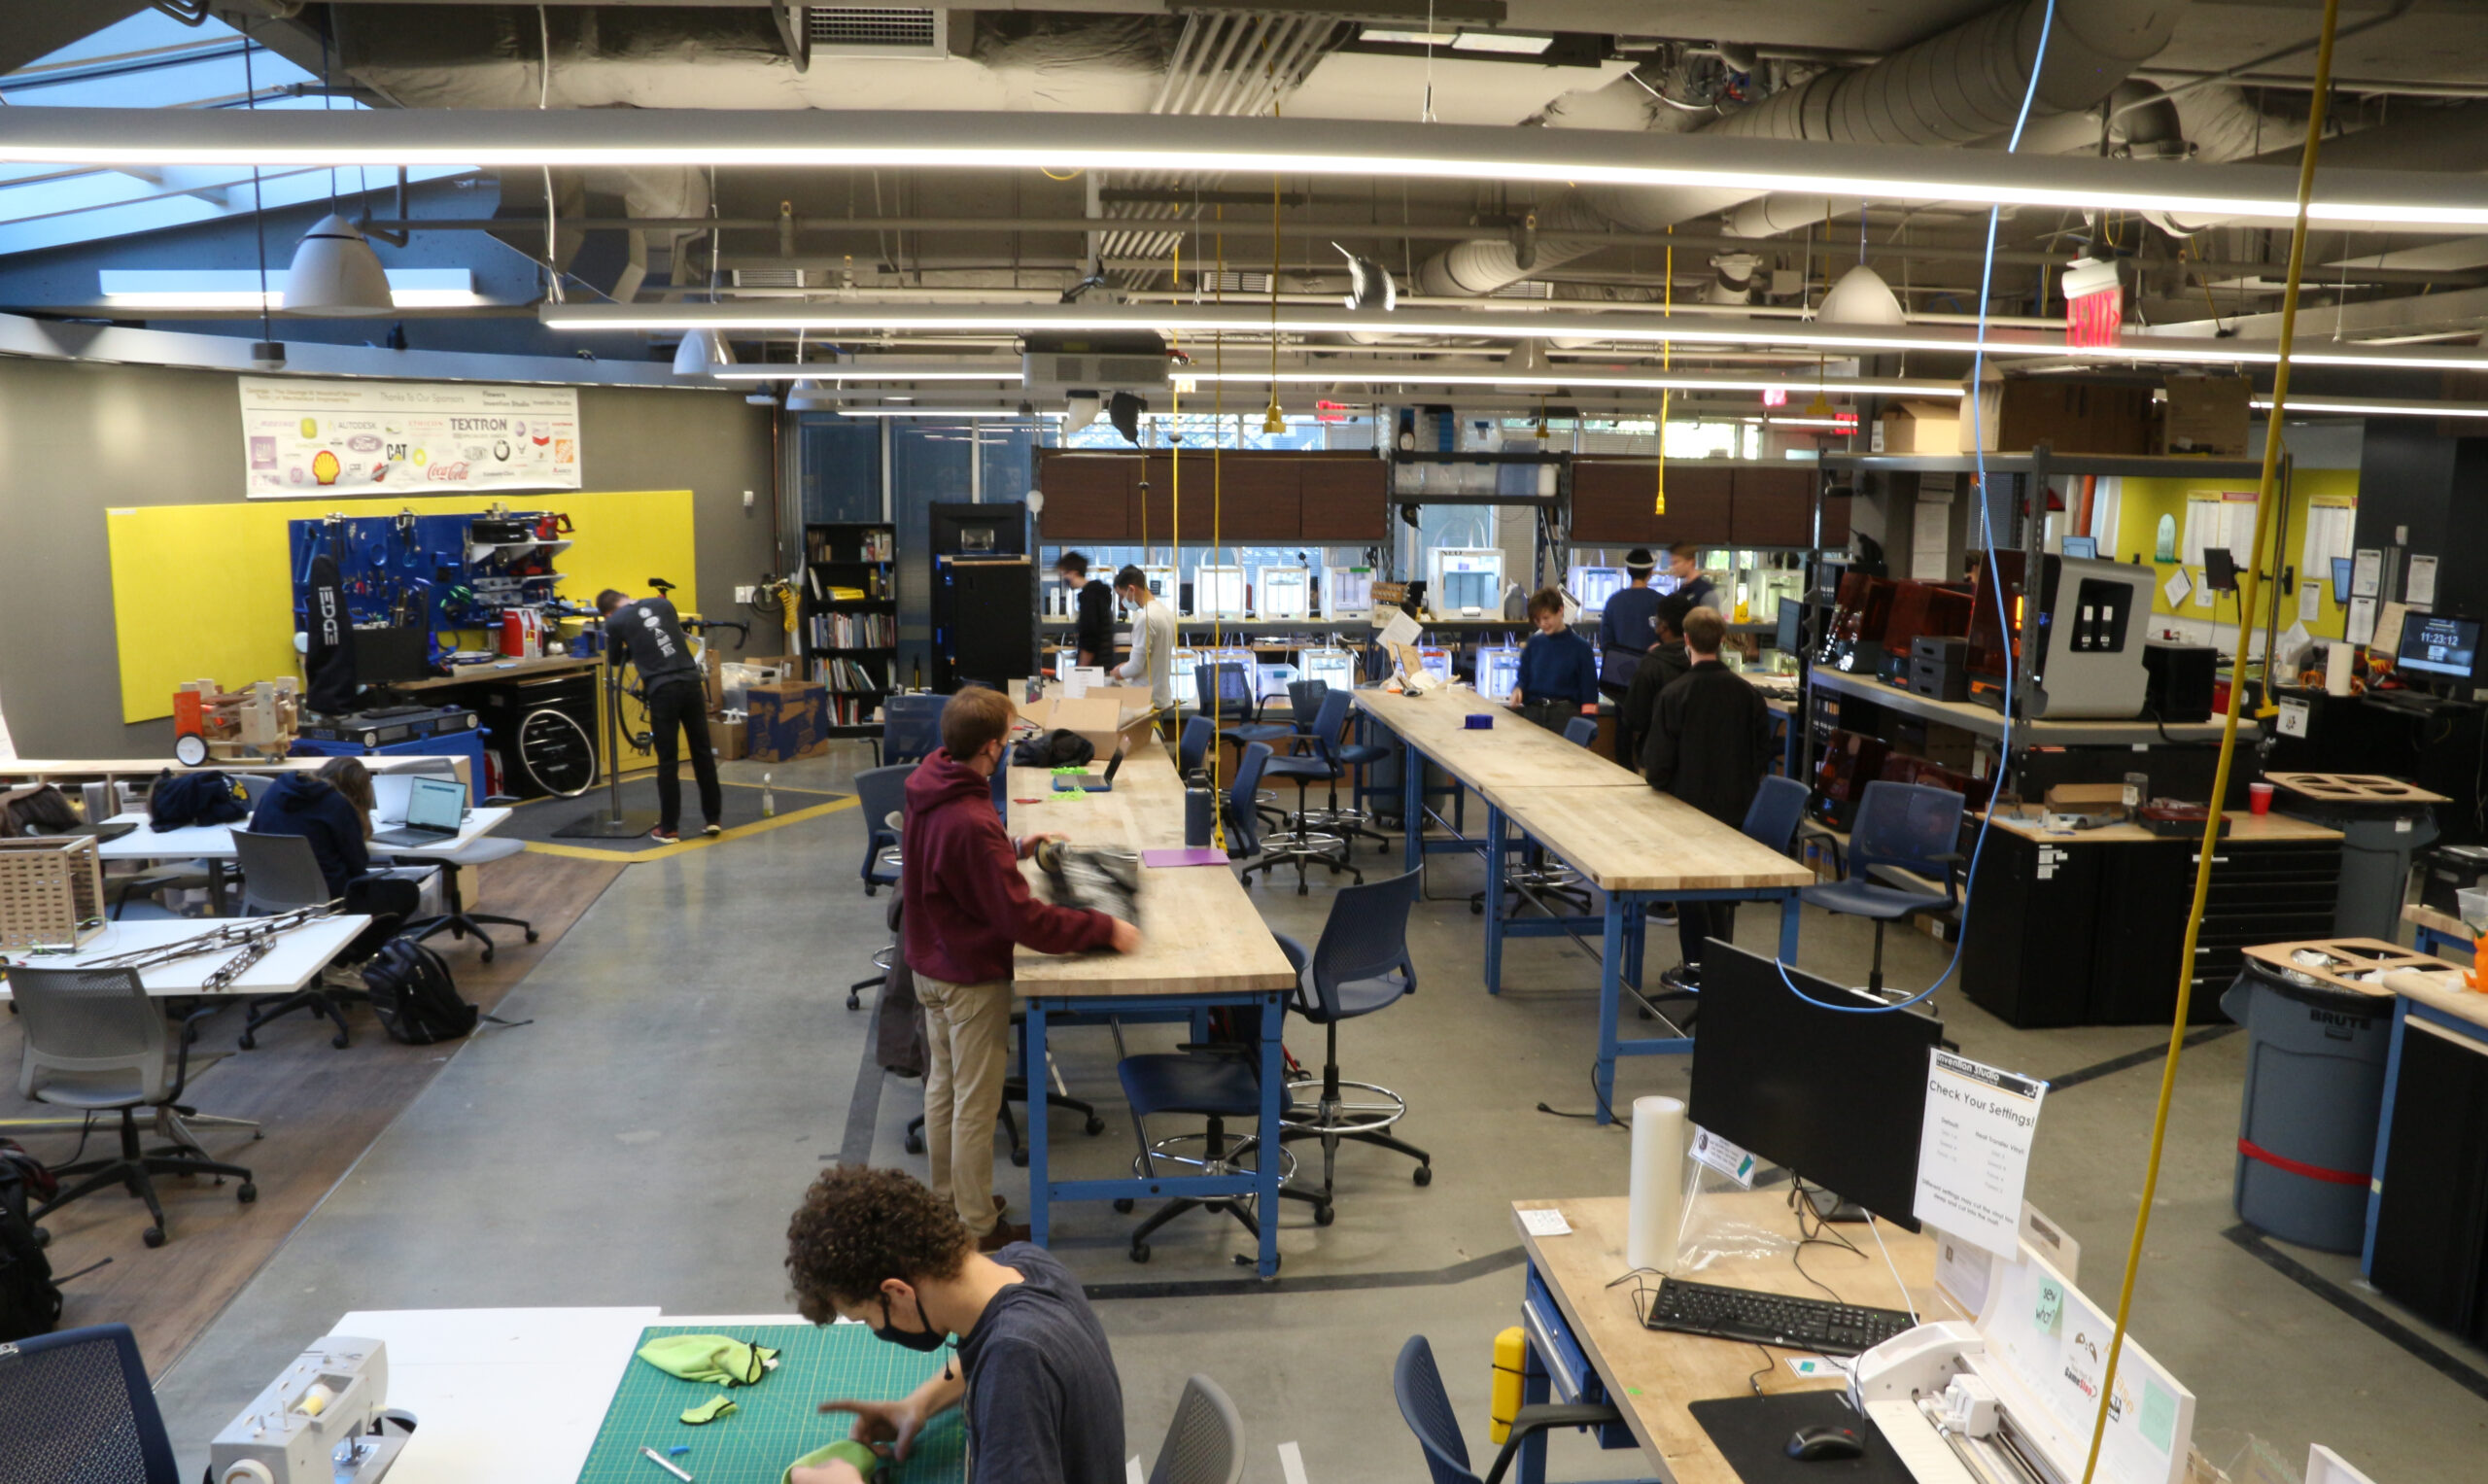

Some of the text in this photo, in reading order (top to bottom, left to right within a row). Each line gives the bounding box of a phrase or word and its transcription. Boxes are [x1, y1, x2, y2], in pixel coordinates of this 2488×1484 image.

[2075, 291, 2115, 347] EXIT
[380, 392, 405, 402] Thanks
[407, 392, 416, 401] To
[417, 393, 430, 402] Our
[337, 420, 378, 431] AUTODESK
[449, 418, 507, 431] TEXTRON
[386, 443, 407, 462] CAT
[318, 585, 339, 646] EDGE
[2420, 631, 2459, 647] 11:23:12
[2309, 1008, 2372, 1031] BRUTE
[1974, 1061, 2000, 1082] Studio
[1929, 1080, 2036, 1128] Check Your Settings!
[2043, 1287, 2057, 1302] sew
